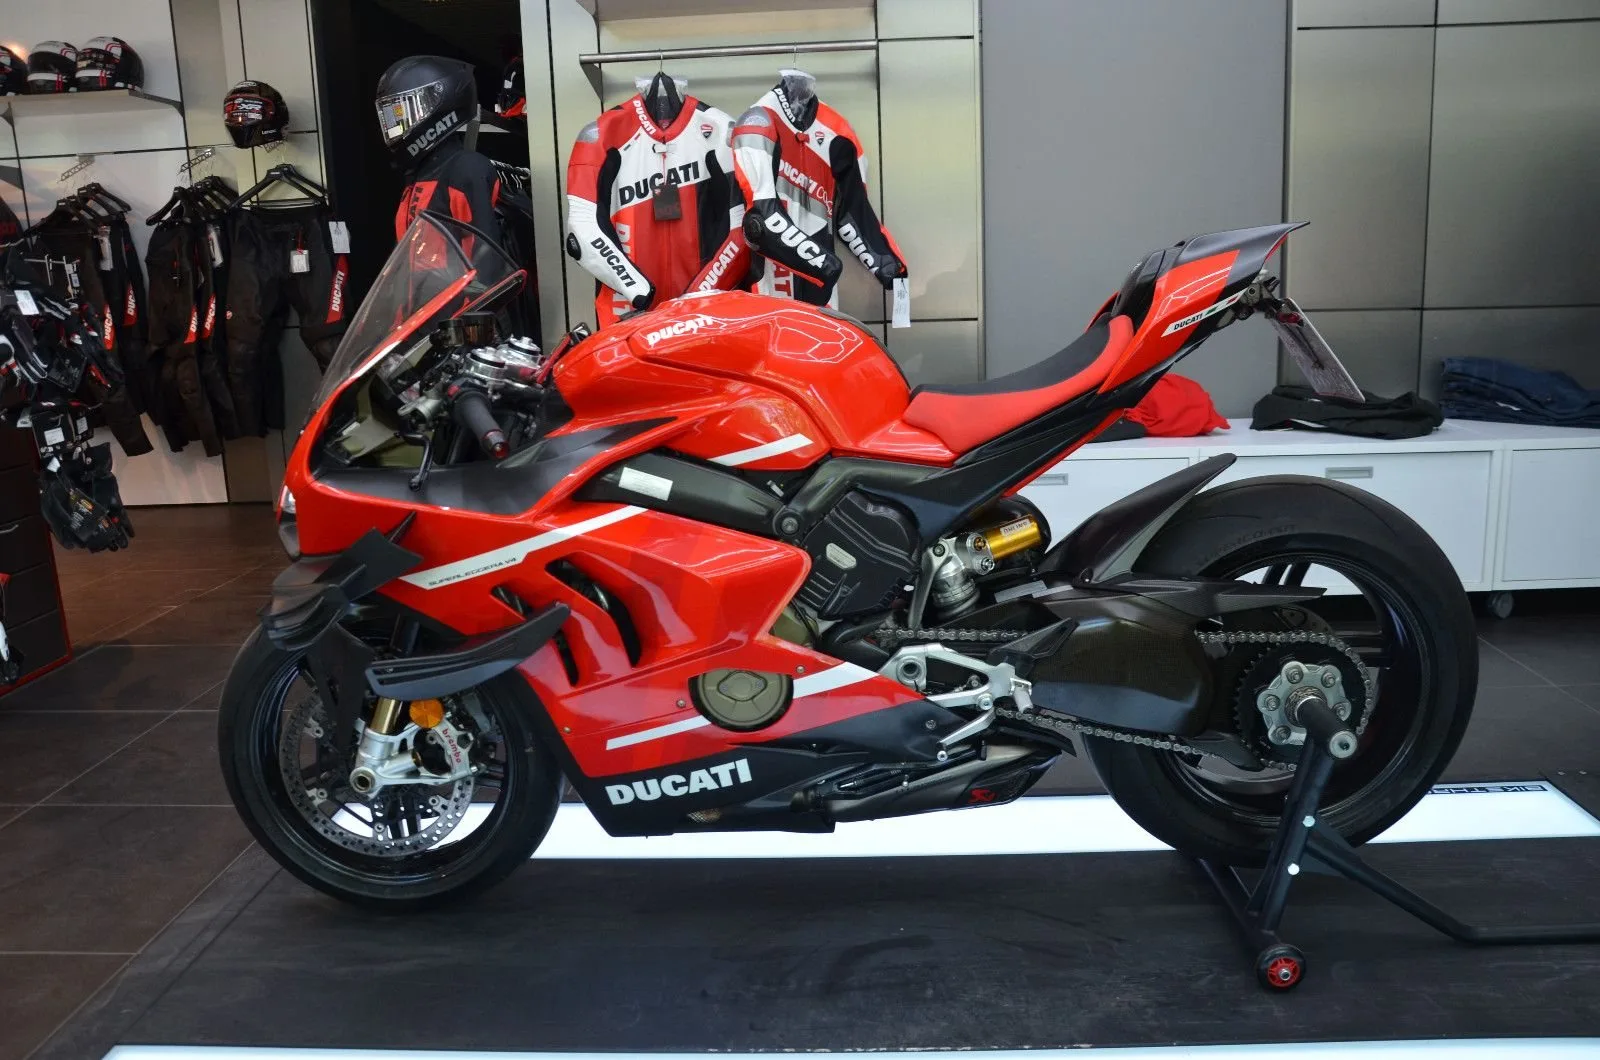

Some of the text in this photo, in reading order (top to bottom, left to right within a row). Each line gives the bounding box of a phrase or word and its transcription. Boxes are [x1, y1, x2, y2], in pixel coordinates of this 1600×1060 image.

[633, 100, 657, 135] DUCATI
[774, 87, 796, 123] DUCATI
[407, 110, 459, 157] DUCATI
[619, 161, 701, 206] DUCATI
[590, 236, 637, 288] DUCATI
[764, 211, 827, 269] DUCA
[838, 222, 880, 275] DUC
[697, 241, 740, 291] DUCATI
[331, 270, 345, 312] DUCATI
[646, 317, 714, 346] DUCATI
[1173, 312, 1204, 331] DUCATI
[442, 728, 461, 763] brembo
[605, 758, 753, 806] DUCATI
